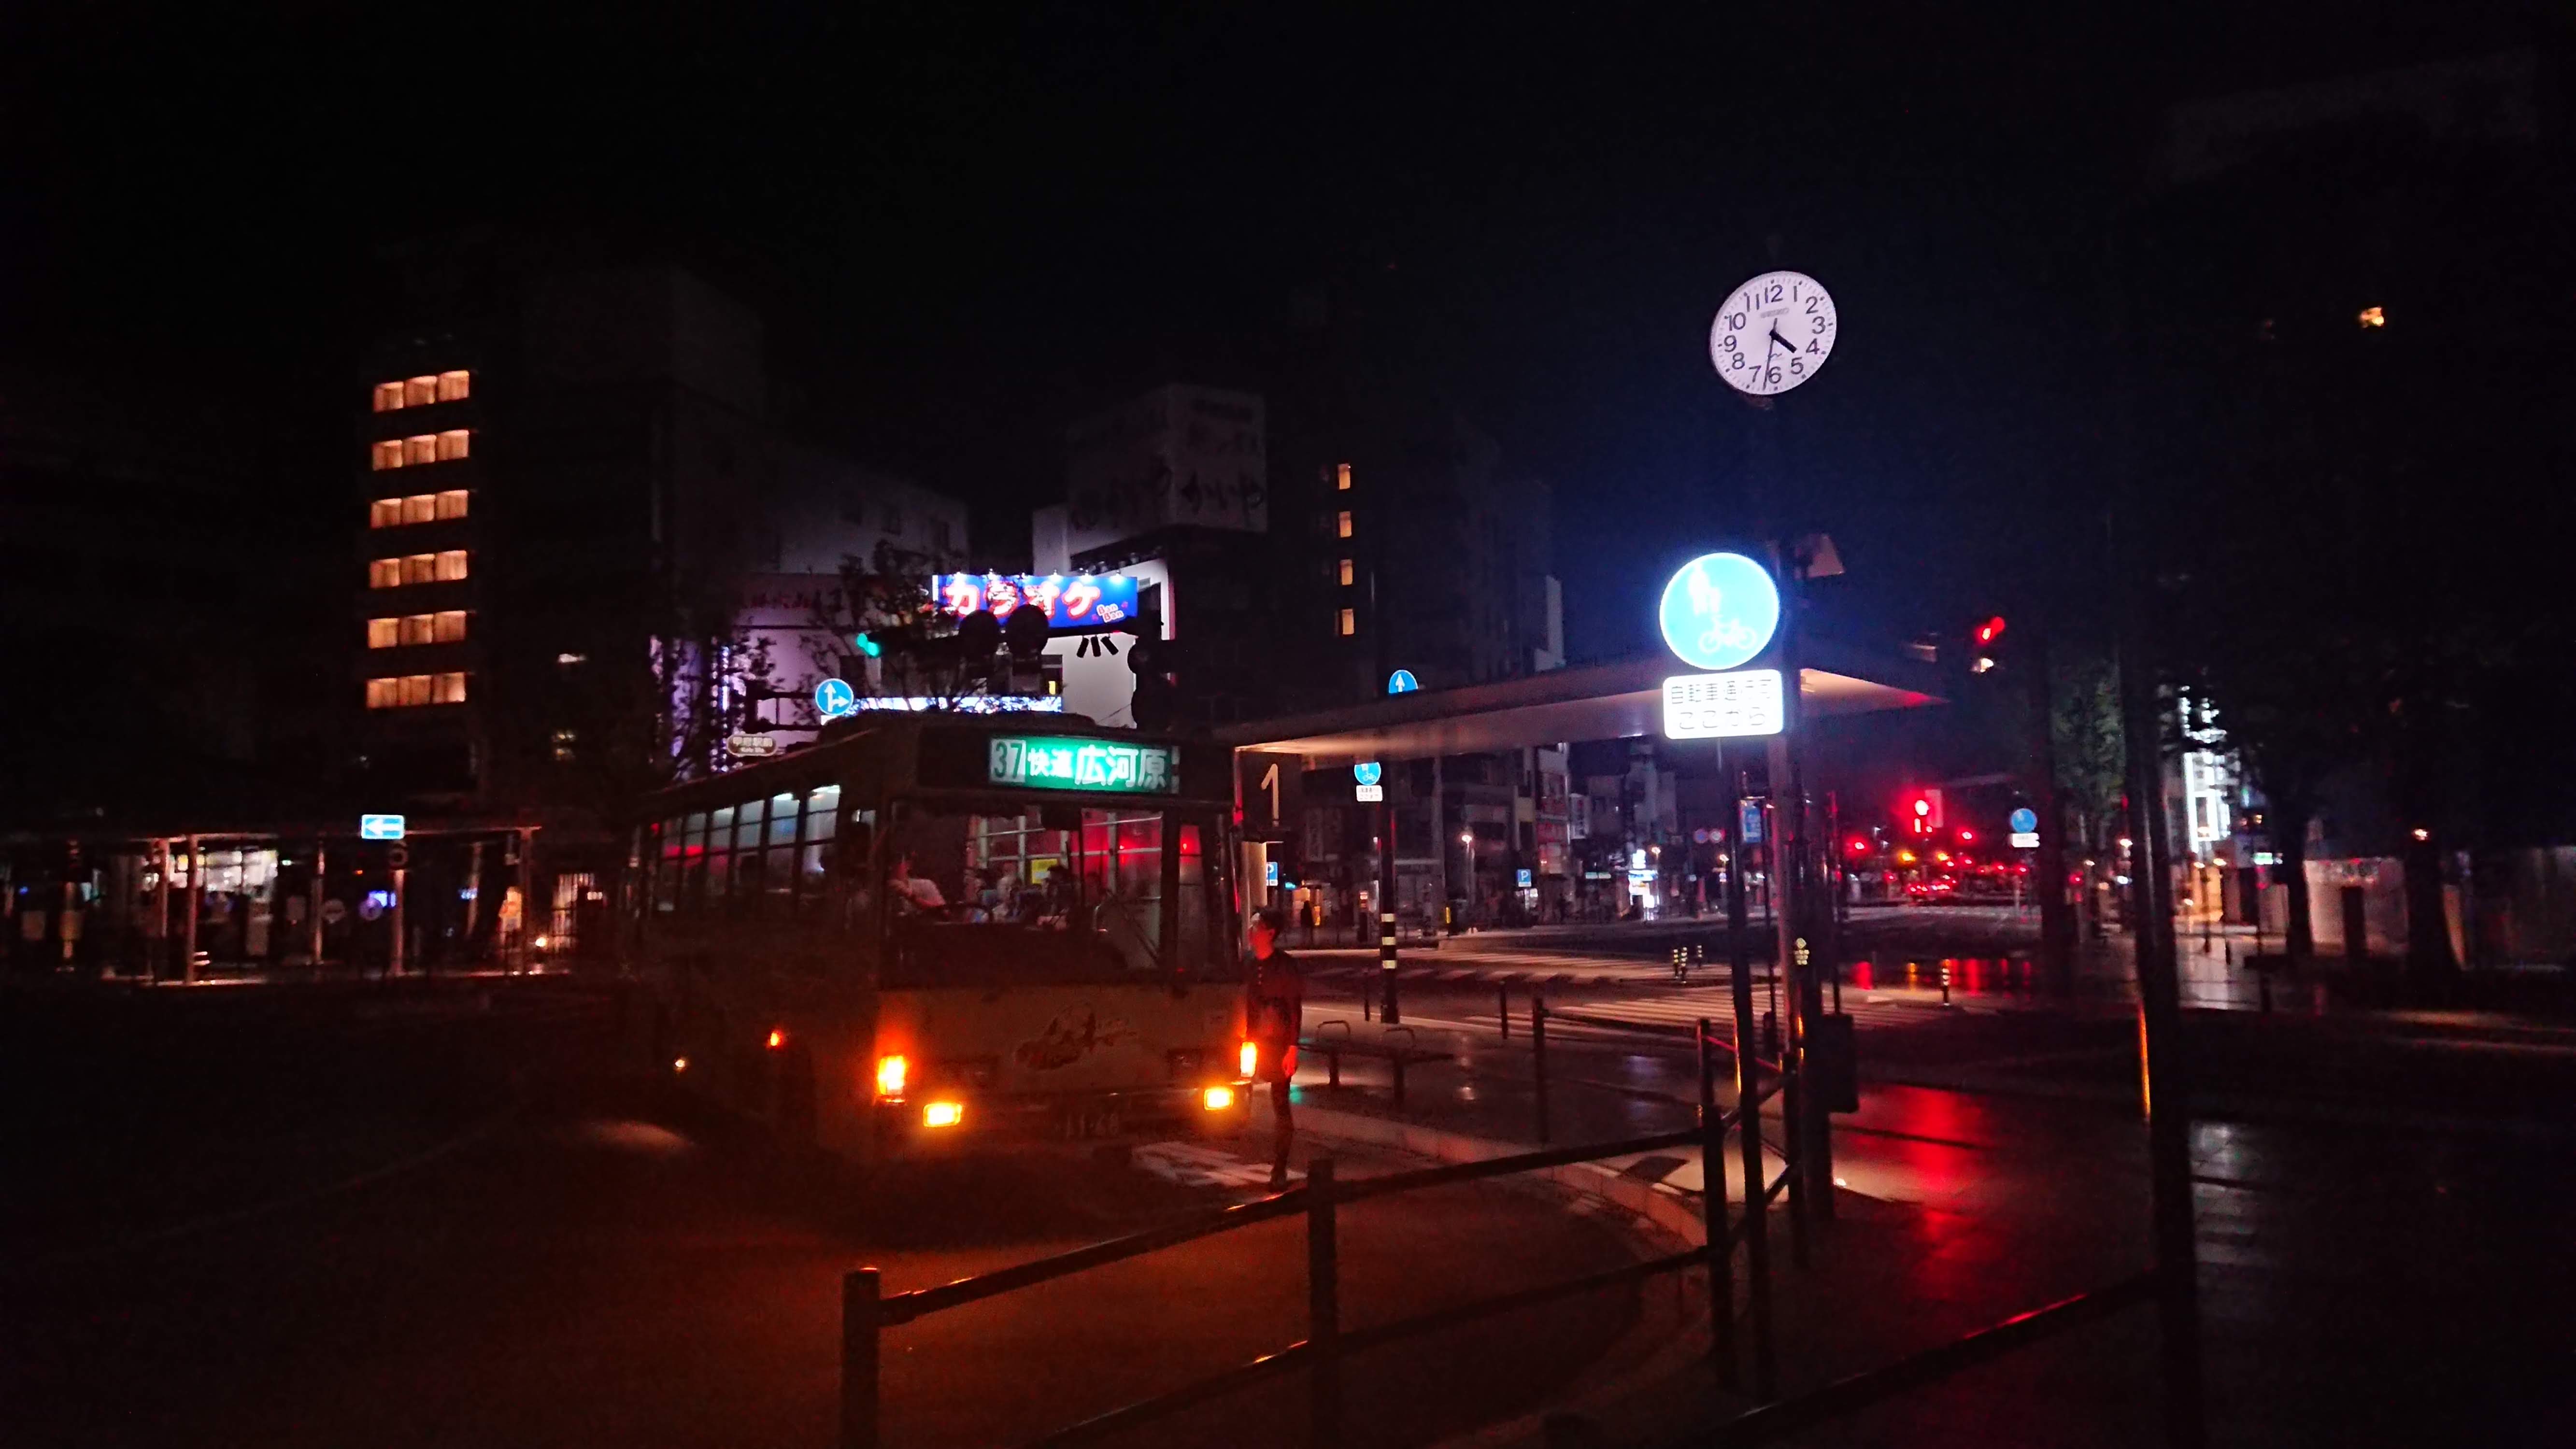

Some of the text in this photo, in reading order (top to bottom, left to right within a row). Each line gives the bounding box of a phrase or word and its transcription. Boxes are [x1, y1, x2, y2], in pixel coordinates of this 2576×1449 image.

[1765, 284, 1783, 303] 12
[1793, 285, 1797, 302] 1
[1746, 293, 1760, 312] 11
[1806, 296, 1819, 314] 2
[1728, 313, 1746, 331] 10
[1812, 316, 1826, 334] 3
[1723, 335, 1737, 352] 9
[1806, 339, 1820, 355] 4
[1732, 352, 1745, 369] 8
[1791, 357, 1804, 374] 5
[1749, 366, 1761, 383] 7
[1768, 367, 1782, 384] 6
[943, 581, 1100, 621] カラオケ
[1103, 611, 1123, 622] Ban
[1679, 707, 1765, 729] ここから
[994, 742, 1022, 779] 37
[1074, 744, 1167, 789] 広河原
[1261, 763, 1279, 826] 1
[1266, 864, 1274, 878] P
[1521, 870, 1528, 881] P
